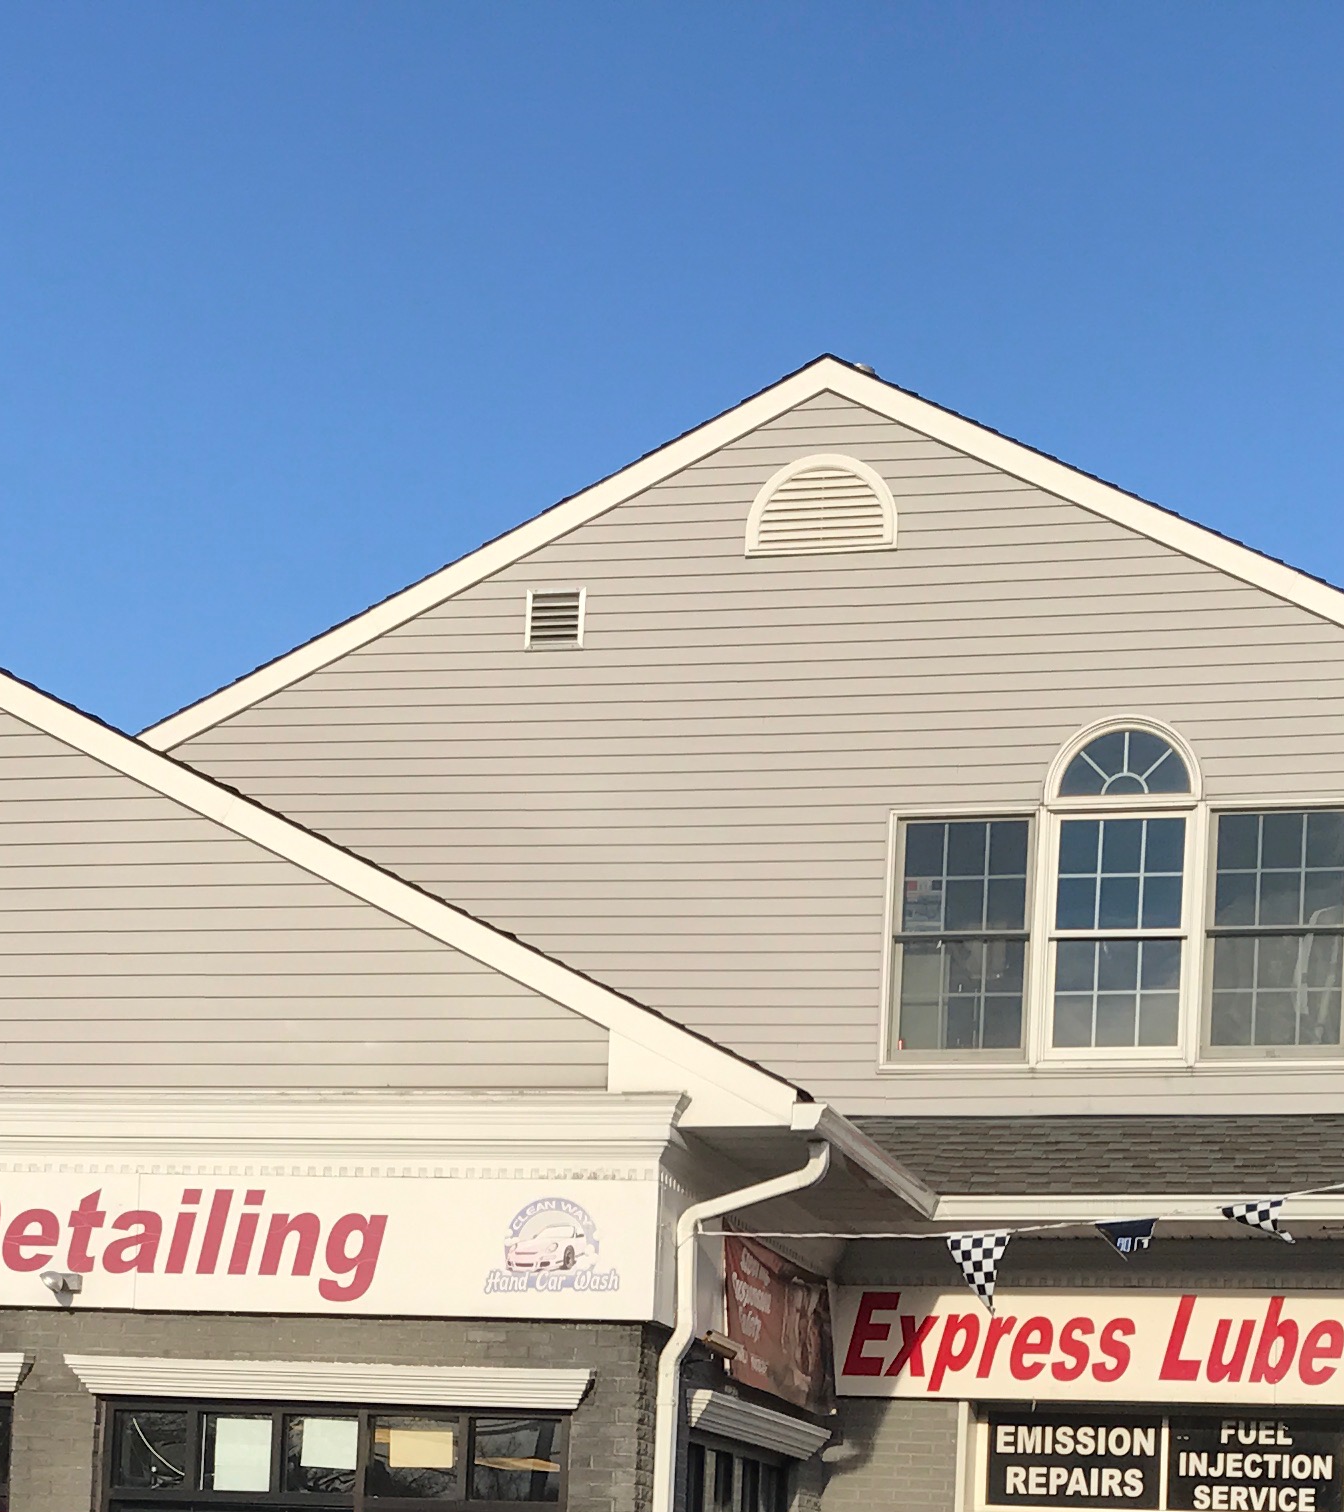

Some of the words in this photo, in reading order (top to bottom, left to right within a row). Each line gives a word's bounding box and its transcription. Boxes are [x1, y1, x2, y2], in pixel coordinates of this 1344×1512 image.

[512, 1200, 556, 1230] CLEAN
[561, 1201, 593, 1227] WAY
[486, 1271, 528, 1293] Hand
[535, 1272, 567, 1291] Car
[574, 1270, 619, 1291] Wash
[840, 1292, 1136, 1389] Express
[1159, 1295, 1344, 1384] Lube
[996, 1425, 1155, 1457] EMISSION
[1220, 1420, 1292, 1446] FUEL
[1178, 1451, 1333, 1480] INJECTION
[1006, 1466, 1144, 1498] REPAIRS
[1193, 1485, 1316, 1512] SERVICE
